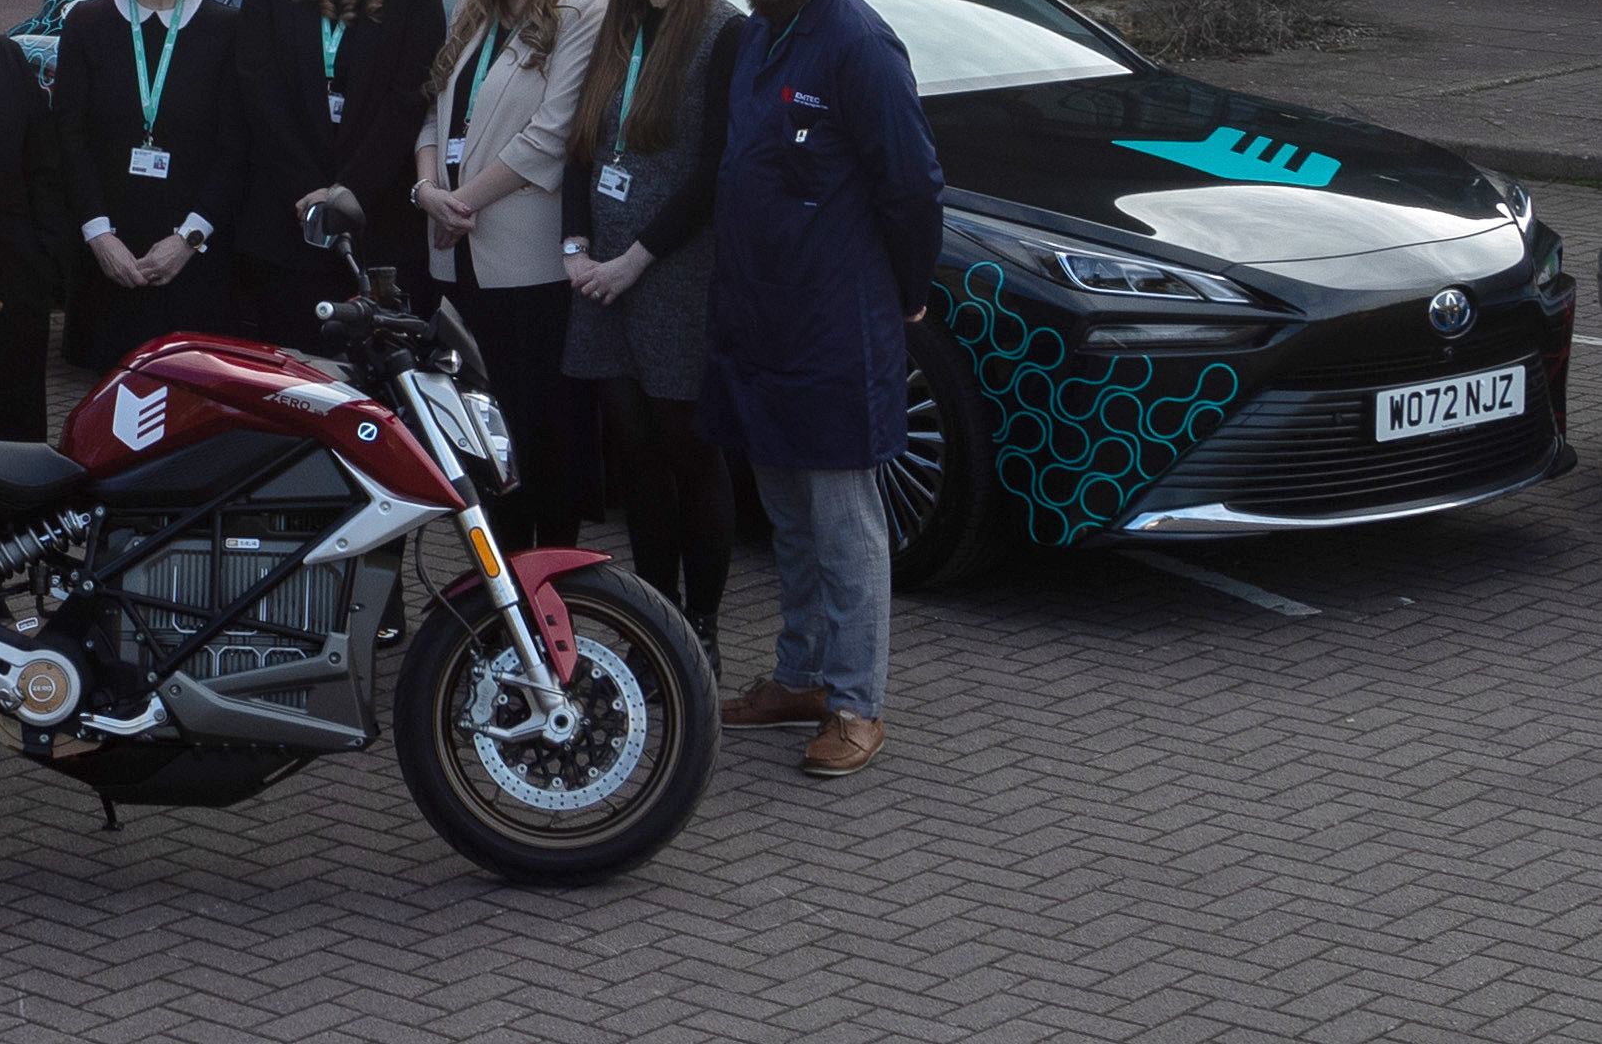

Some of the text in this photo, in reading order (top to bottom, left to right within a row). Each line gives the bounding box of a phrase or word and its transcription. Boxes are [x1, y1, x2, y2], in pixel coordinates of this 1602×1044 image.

[266, 392, 312, 412] ZERO
[1389, 373, 1514, 431] WO72 NJZ
